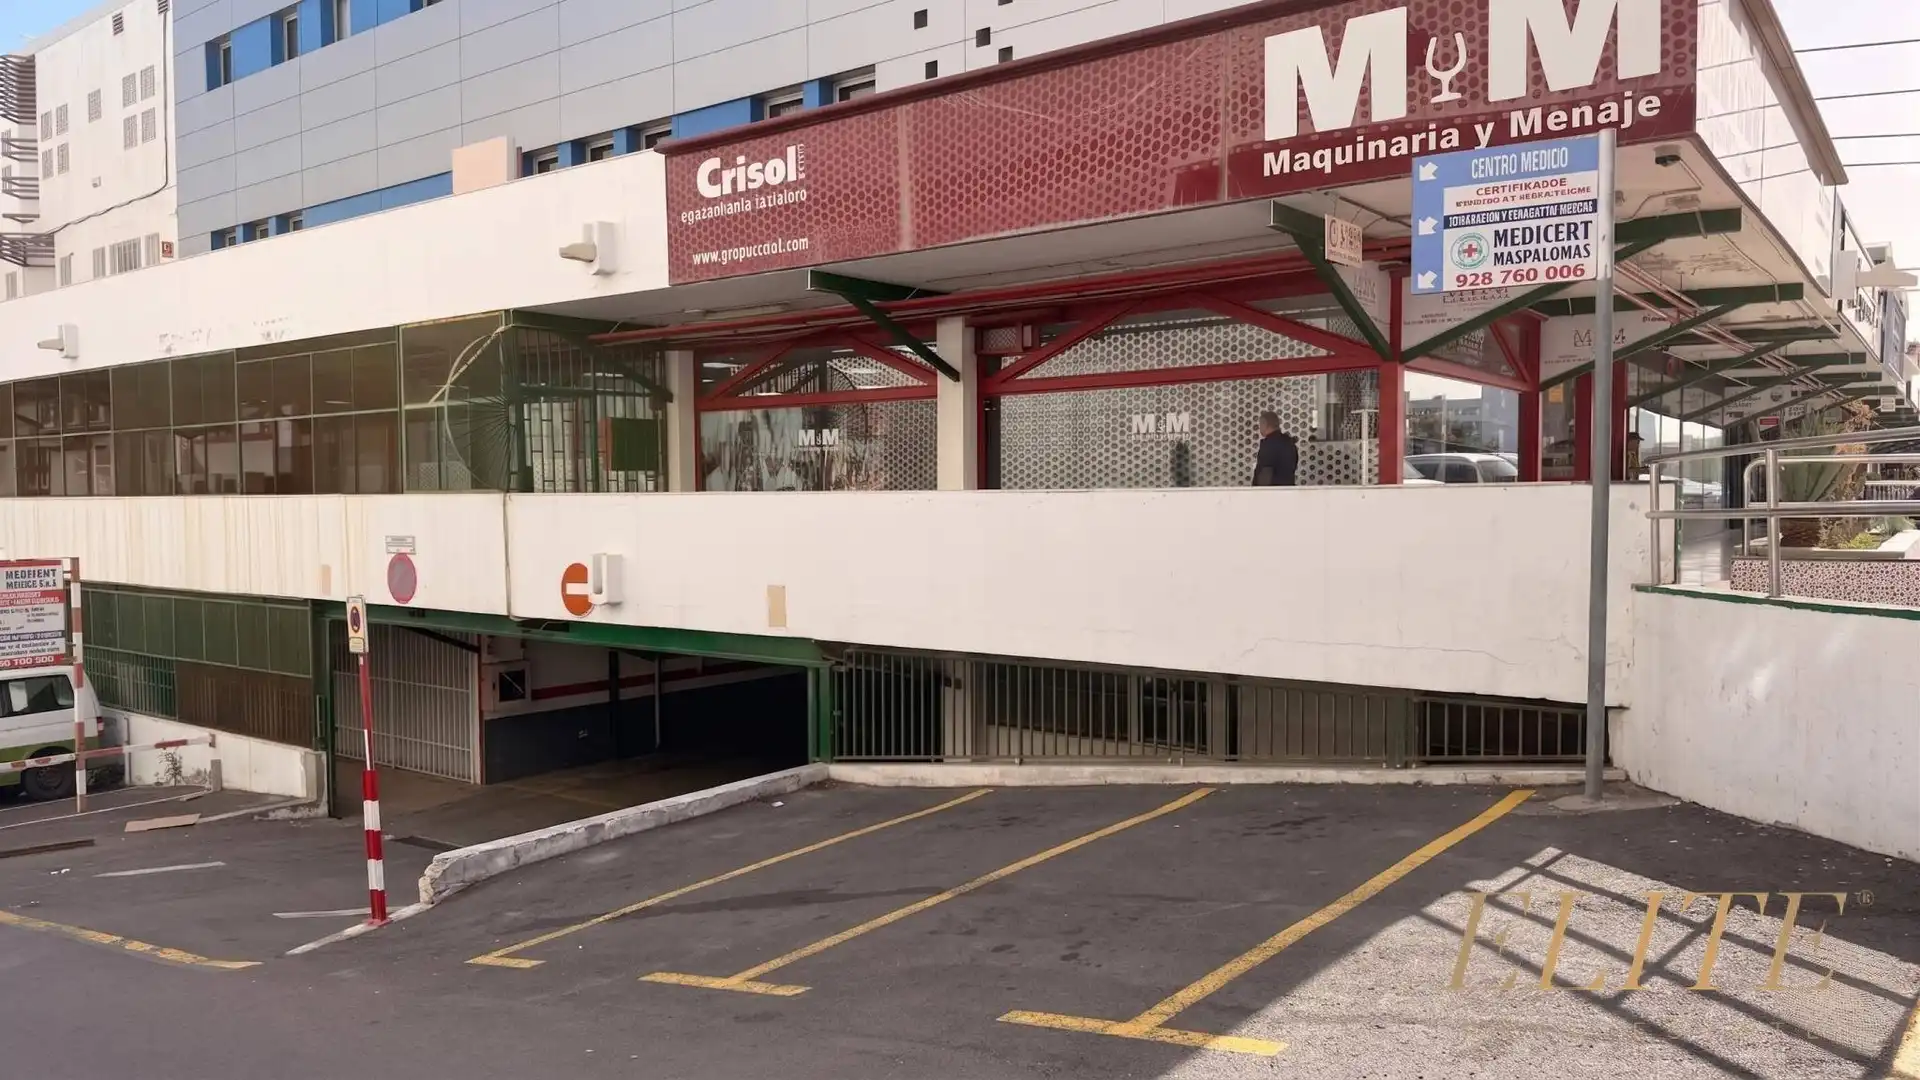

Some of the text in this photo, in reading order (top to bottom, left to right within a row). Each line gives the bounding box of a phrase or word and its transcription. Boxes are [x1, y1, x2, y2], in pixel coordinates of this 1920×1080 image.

[1263, 90, 1661, 177] Maquinaria y Menaje
[696, 144, 797, 198] Crisol
[1471, 154, 1518, 180] CENTRO
[1493, 219, 1593, 249] MEDICERT
[1493, 242, 1592, 267] MASPALOMAS
[1455, 263, 1586, 288] 928 760 006
